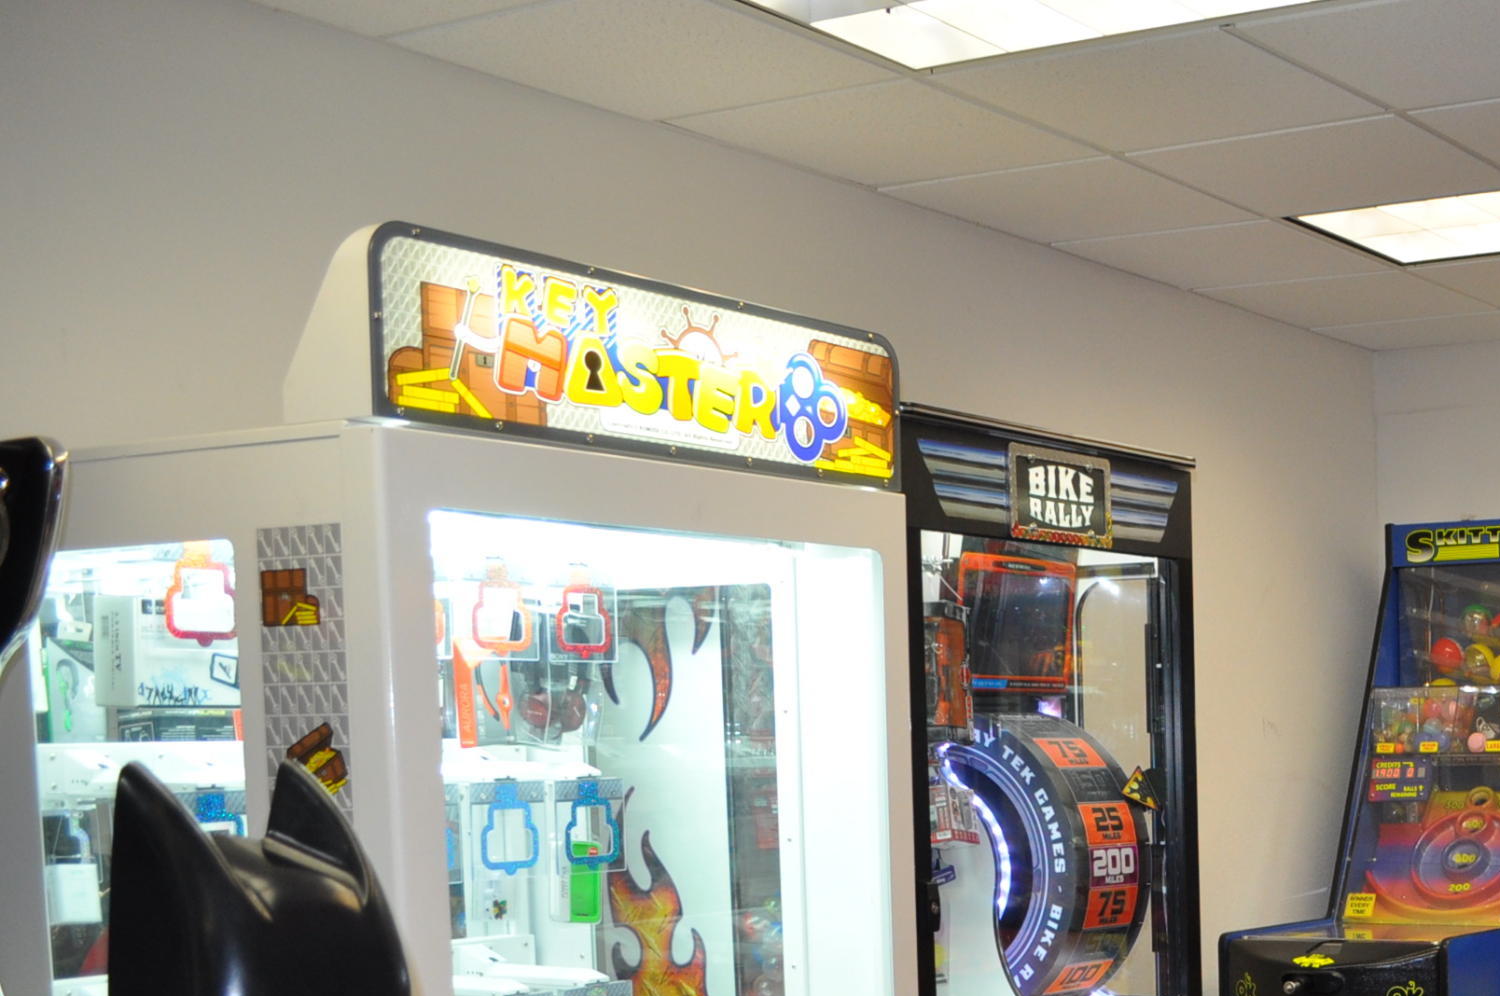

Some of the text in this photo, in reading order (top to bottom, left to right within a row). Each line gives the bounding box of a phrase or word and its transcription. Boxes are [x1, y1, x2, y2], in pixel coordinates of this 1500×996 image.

[500, 264, 618, 335] KEY
[495, 316, 779, 441] MASTER
[1028, 465, 1095, 500] BIKE
[1029, 497, 1094, 528] RALLY
[1047, 740, 1087, 759] 75
[1002, 745, 1036, 787] TEK
[1034, 788, 1067, 874] GAMES
[1091, 806, 1124, 832] 25
[1092, 847, 1135, 877] 200
[1104, 874, 1125, 885] MILES
[1448, 881, 1472, 893] 200
[1098, 889, 1127, 917] 75
[1034, 903, 1064, 963] BIKE
[1058, 963, 1099, 988] 100
